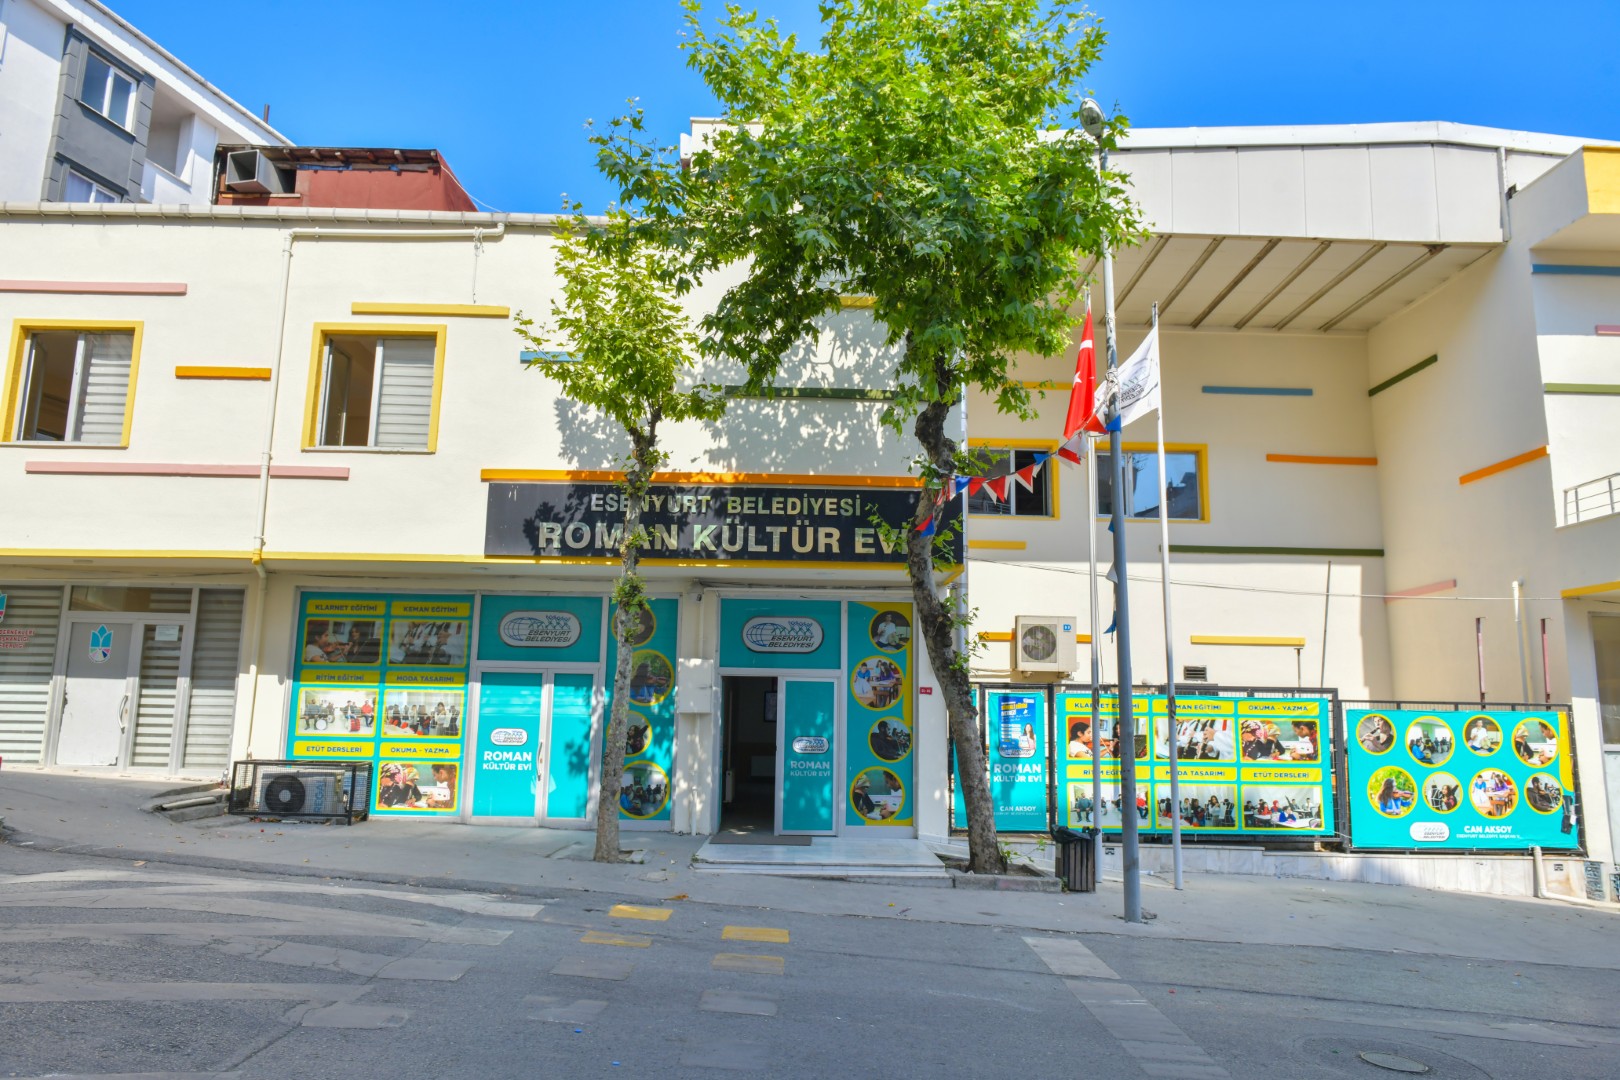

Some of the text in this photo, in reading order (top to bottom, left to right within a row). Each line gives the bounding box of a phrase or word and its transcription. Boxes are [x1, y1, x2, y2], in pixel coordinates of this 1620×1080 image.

[727, 493, 861, 516] BELEDİYESİ
[693, 519, 841, 553] KÜLTÜR
[484, 751, 532, 761] ROMAN
[483, 761, 532, 770] KÜLTÜR EVİ
[790, 760, 830, 769] ROMAN
[993, 763, 1042, 773] ROMAN
[790, 769, 817, 777] KÜLTÜR
[1027, 773, 1042, 782] EVİ
[1463, 825, 1512, 833] CAN AKSOY
